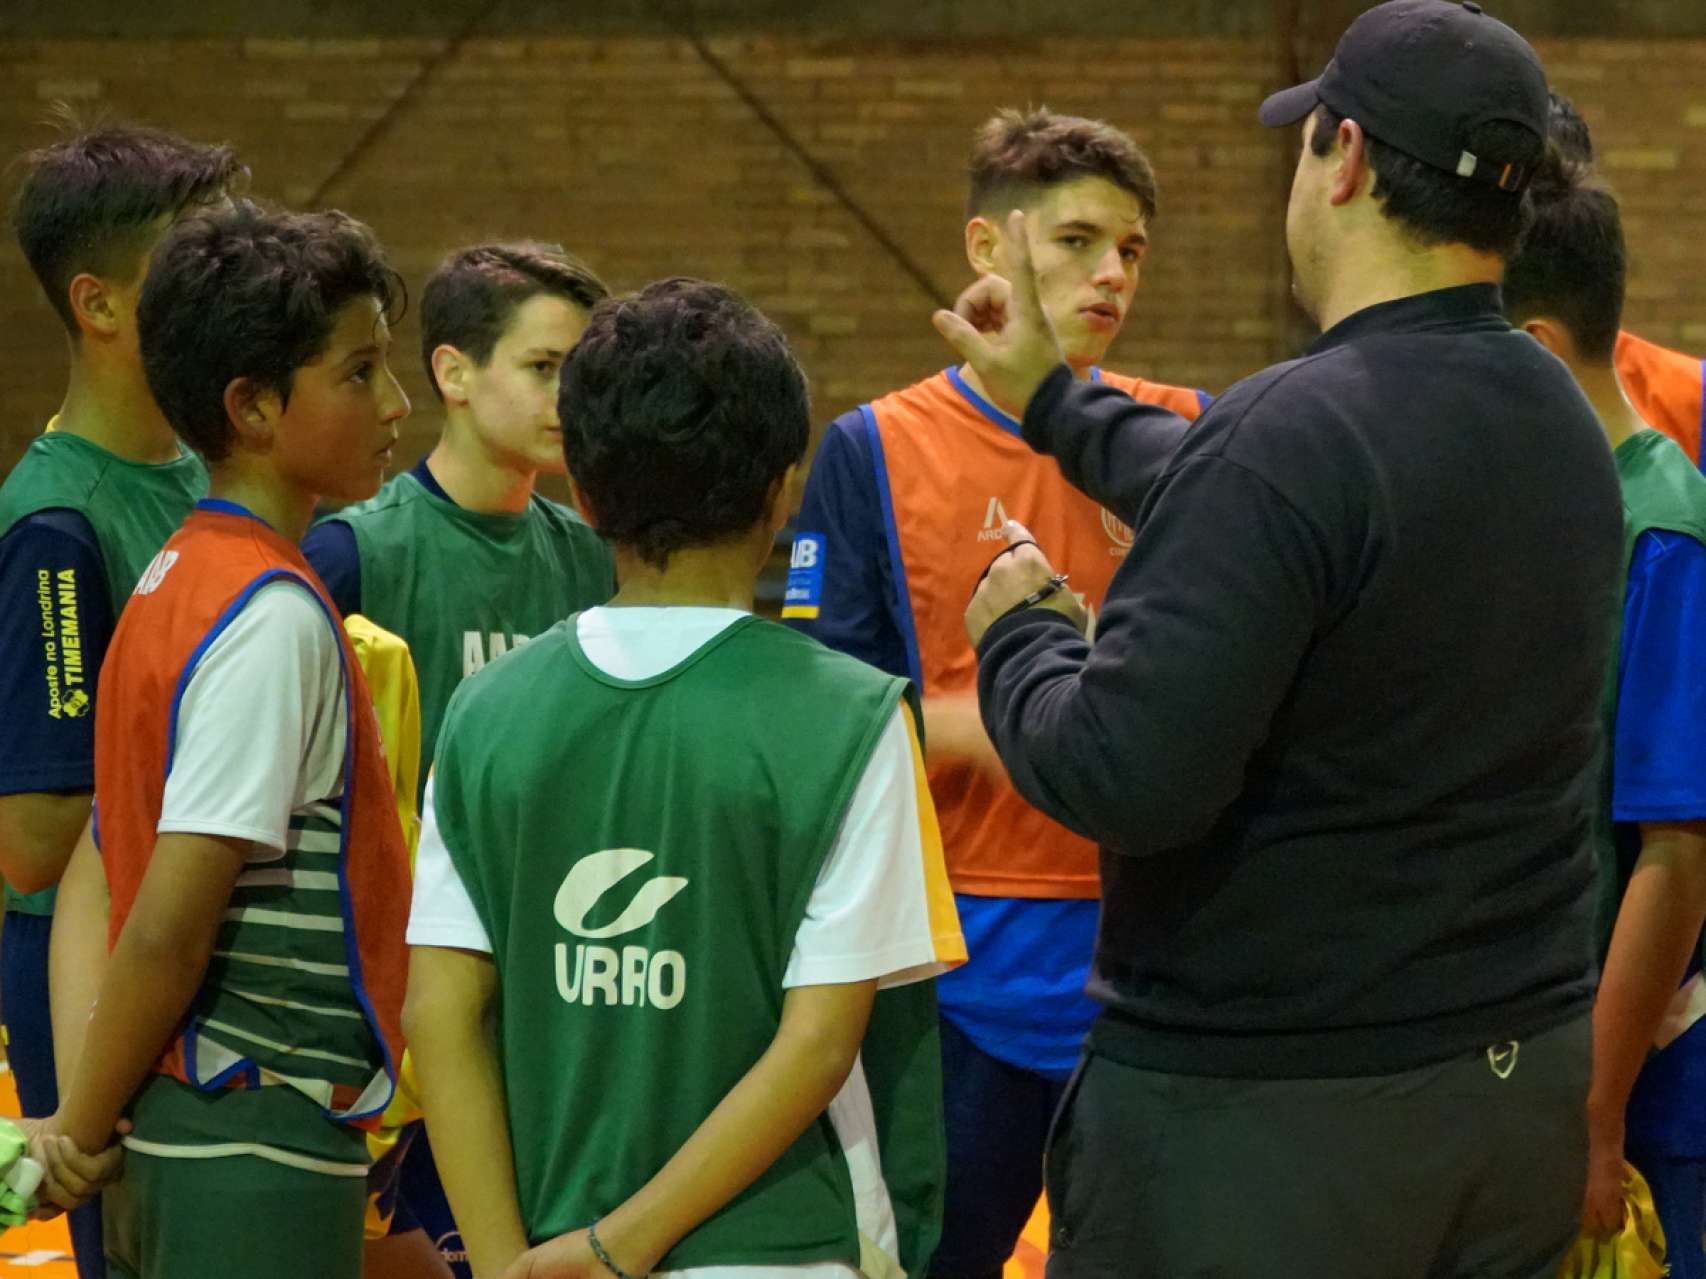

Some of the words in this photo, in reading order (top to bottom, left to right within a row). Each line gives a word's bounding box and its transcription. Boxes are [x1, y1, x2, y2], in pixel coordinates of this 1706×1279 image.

[37, 569, 55, 637] Londrina
[57, 568, 84, 686] TIMEMANIA
[45, 641, 57, 662] no
[462, 630, 530, 678] AA
[45, 664, 62, 719] Aposte
[554, 942, 687, 1010] URRO
